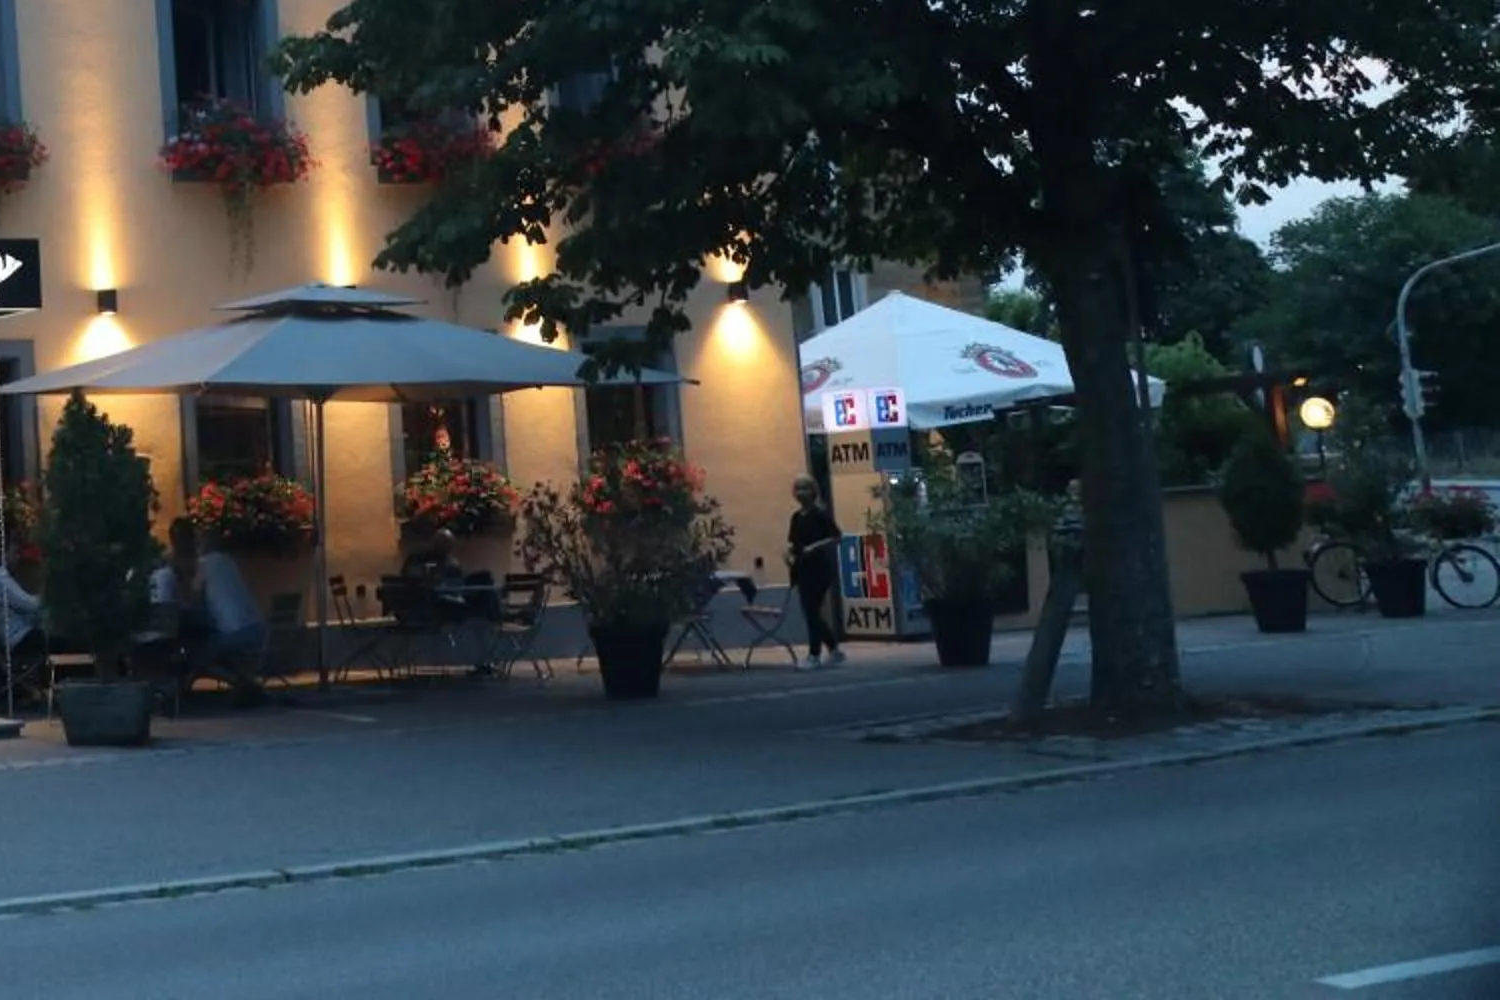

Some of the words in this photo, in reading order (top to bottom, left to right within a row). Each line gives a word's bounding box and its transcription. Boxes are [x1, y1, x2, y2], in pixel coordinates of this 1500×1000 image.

[831, 441, 870, 464] ATM
[876, 441, 909, 458] ATM
[846, 605, 893, 630] ATM
